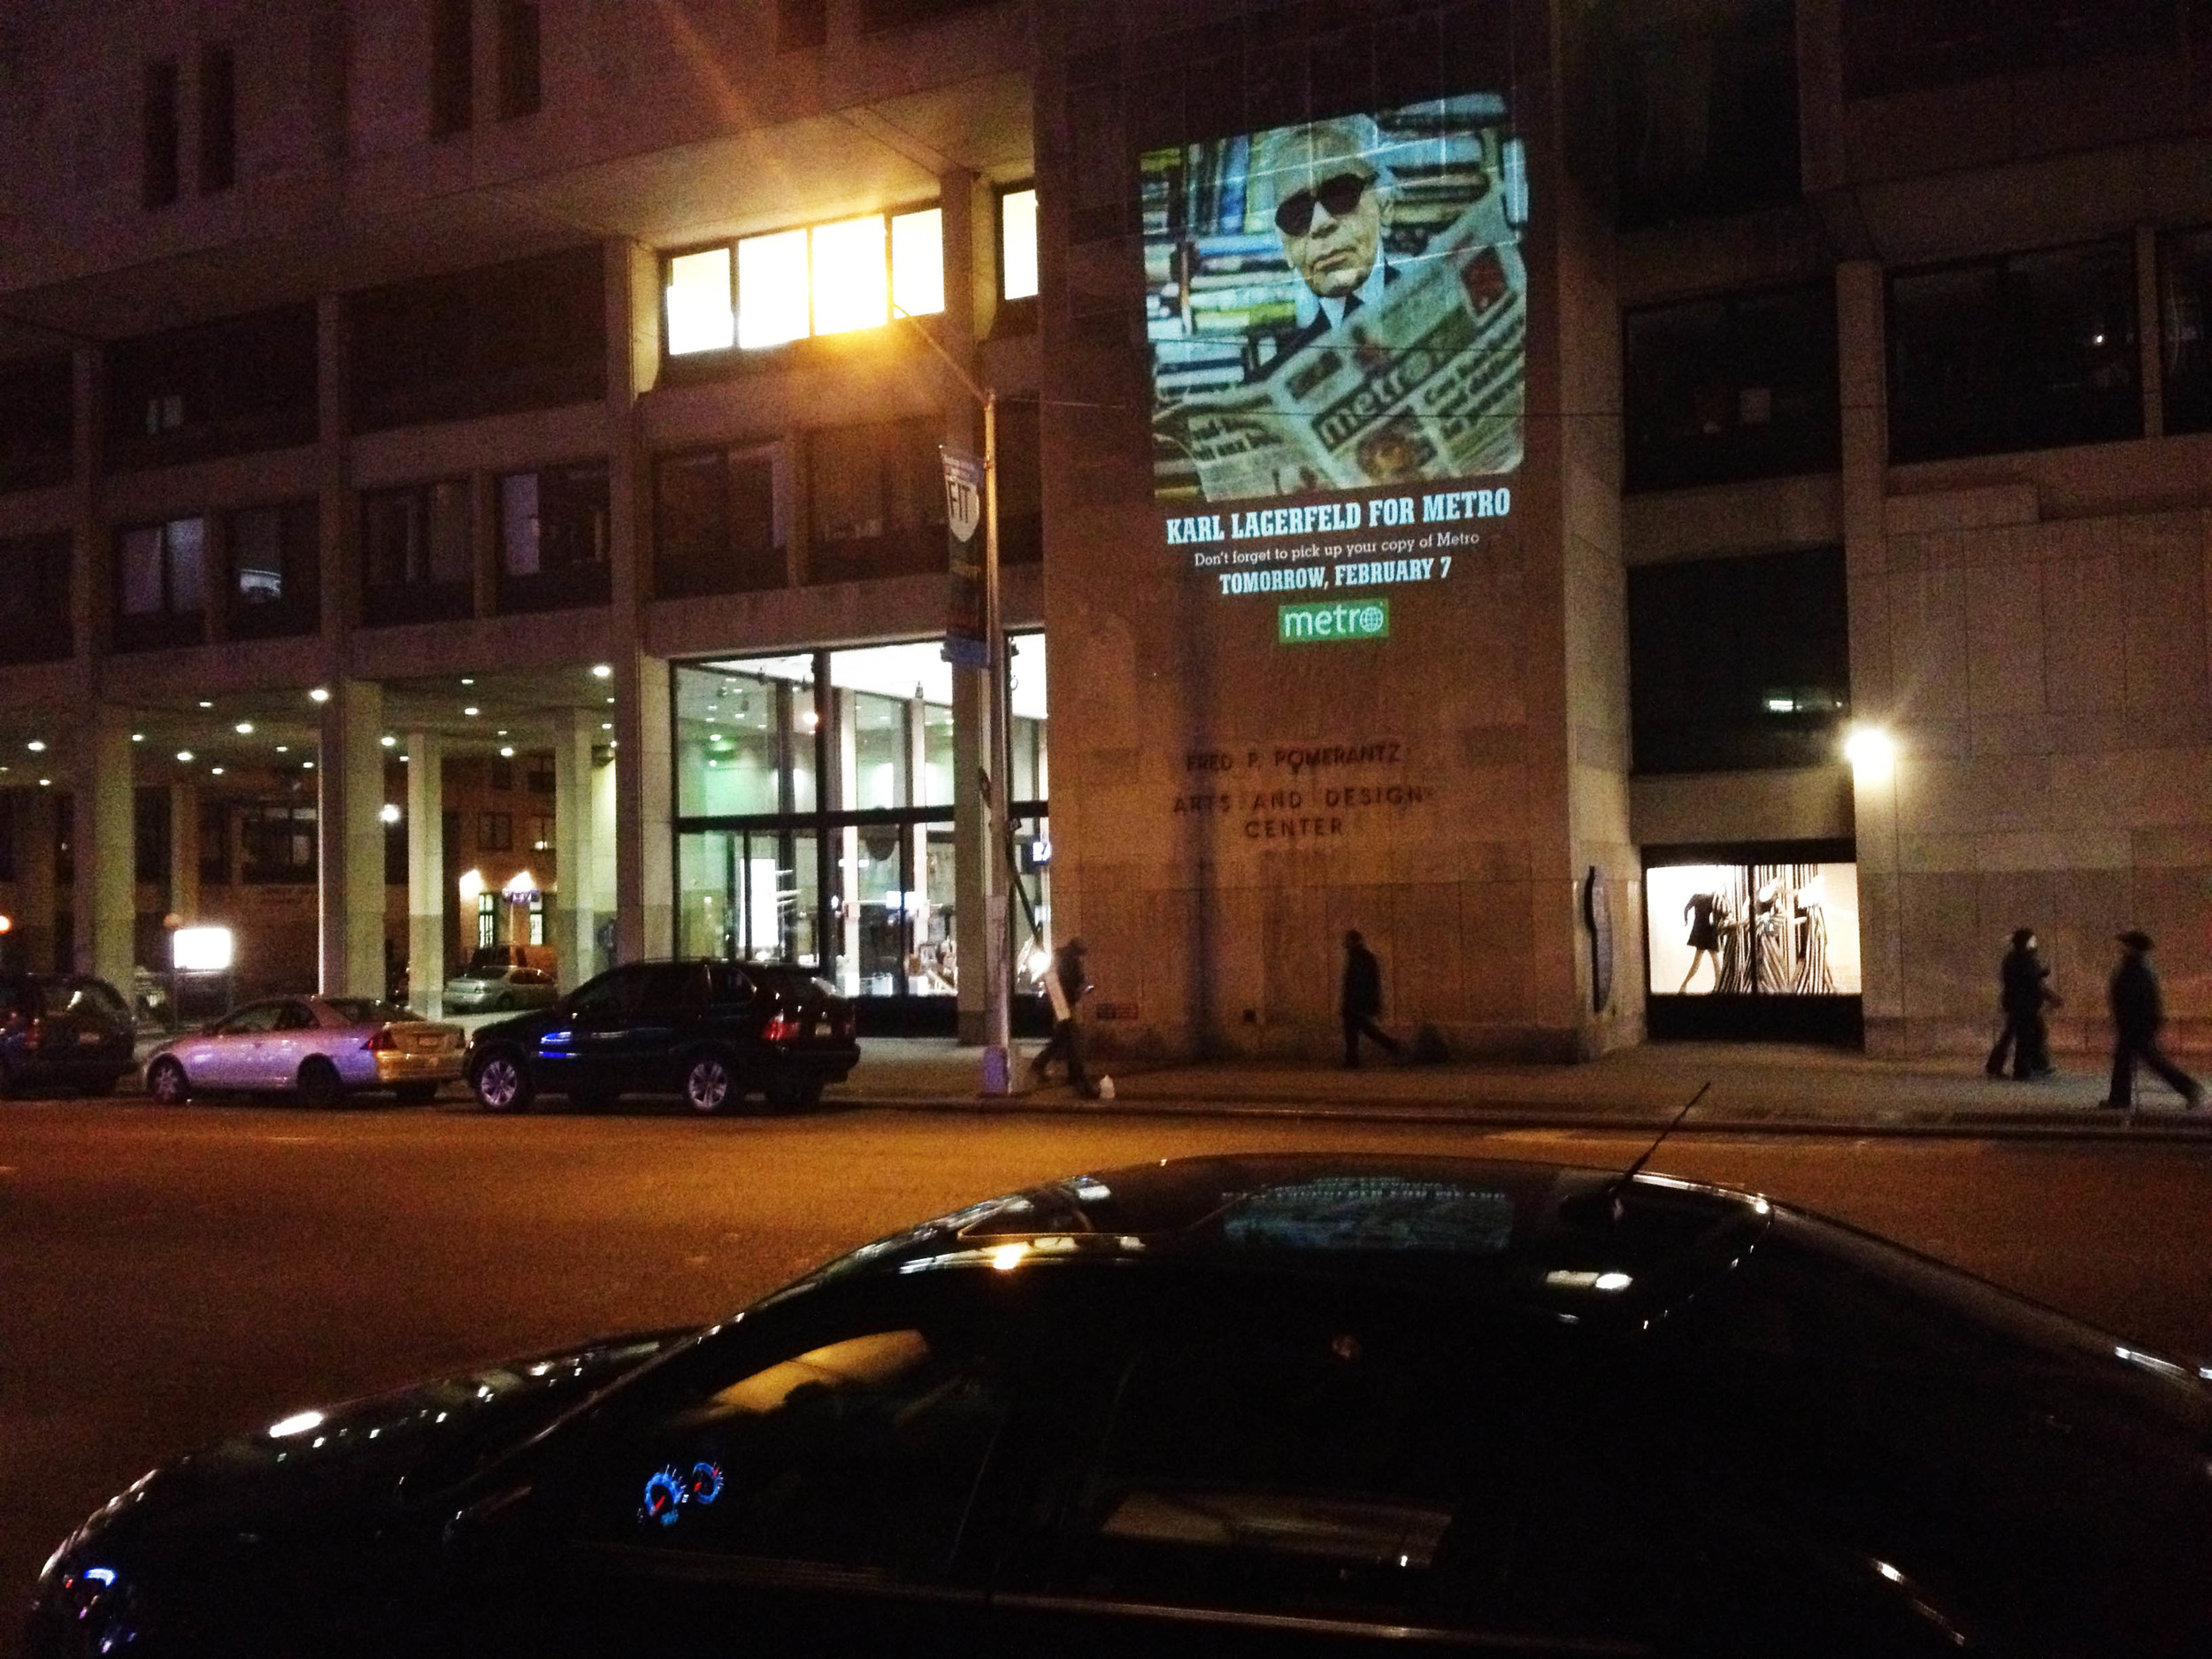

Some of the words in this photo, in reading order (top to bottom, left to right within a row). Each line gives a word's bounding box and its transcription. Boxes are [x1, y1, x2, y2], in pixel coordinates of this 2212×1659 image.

[1166, 515, 1225, 544] KARL
[1231, 502, 1361, 540] LAGERFELD
[1369, 497, 1416, 527] FOR
[1423, 488, 1510, 523] METRO
[1194, 551, 1229, 567] Don't
[1233, 549, 1271, 565] forget
[1275, 548, 1288, 560] to
[1292, 543, 1320, 562] pick
[1325, 544, 1343, 559] up
[1347, 541, 1377, 558] your
[1381, 538, 1416, 553] copy
[1419, 534, 1432, 549] of
[1437, 531, 1480, 548] Metro
[1219, 566, 1329, 595] TOMORROW,
[1334, 557, 1434, 587] FEBRUARY
[1440, 556, 1452, 580] 7
[1285, 603, 1383, 637] metro
[1187, 752, 1233, 772] FRED
[1173, 794, 1231, 813] ARTS
[1253, 790, 1303, 810] AND
[1325, 786, 1423, 807] DESIGN
[1245, 818, 1343, 838] CENTER
